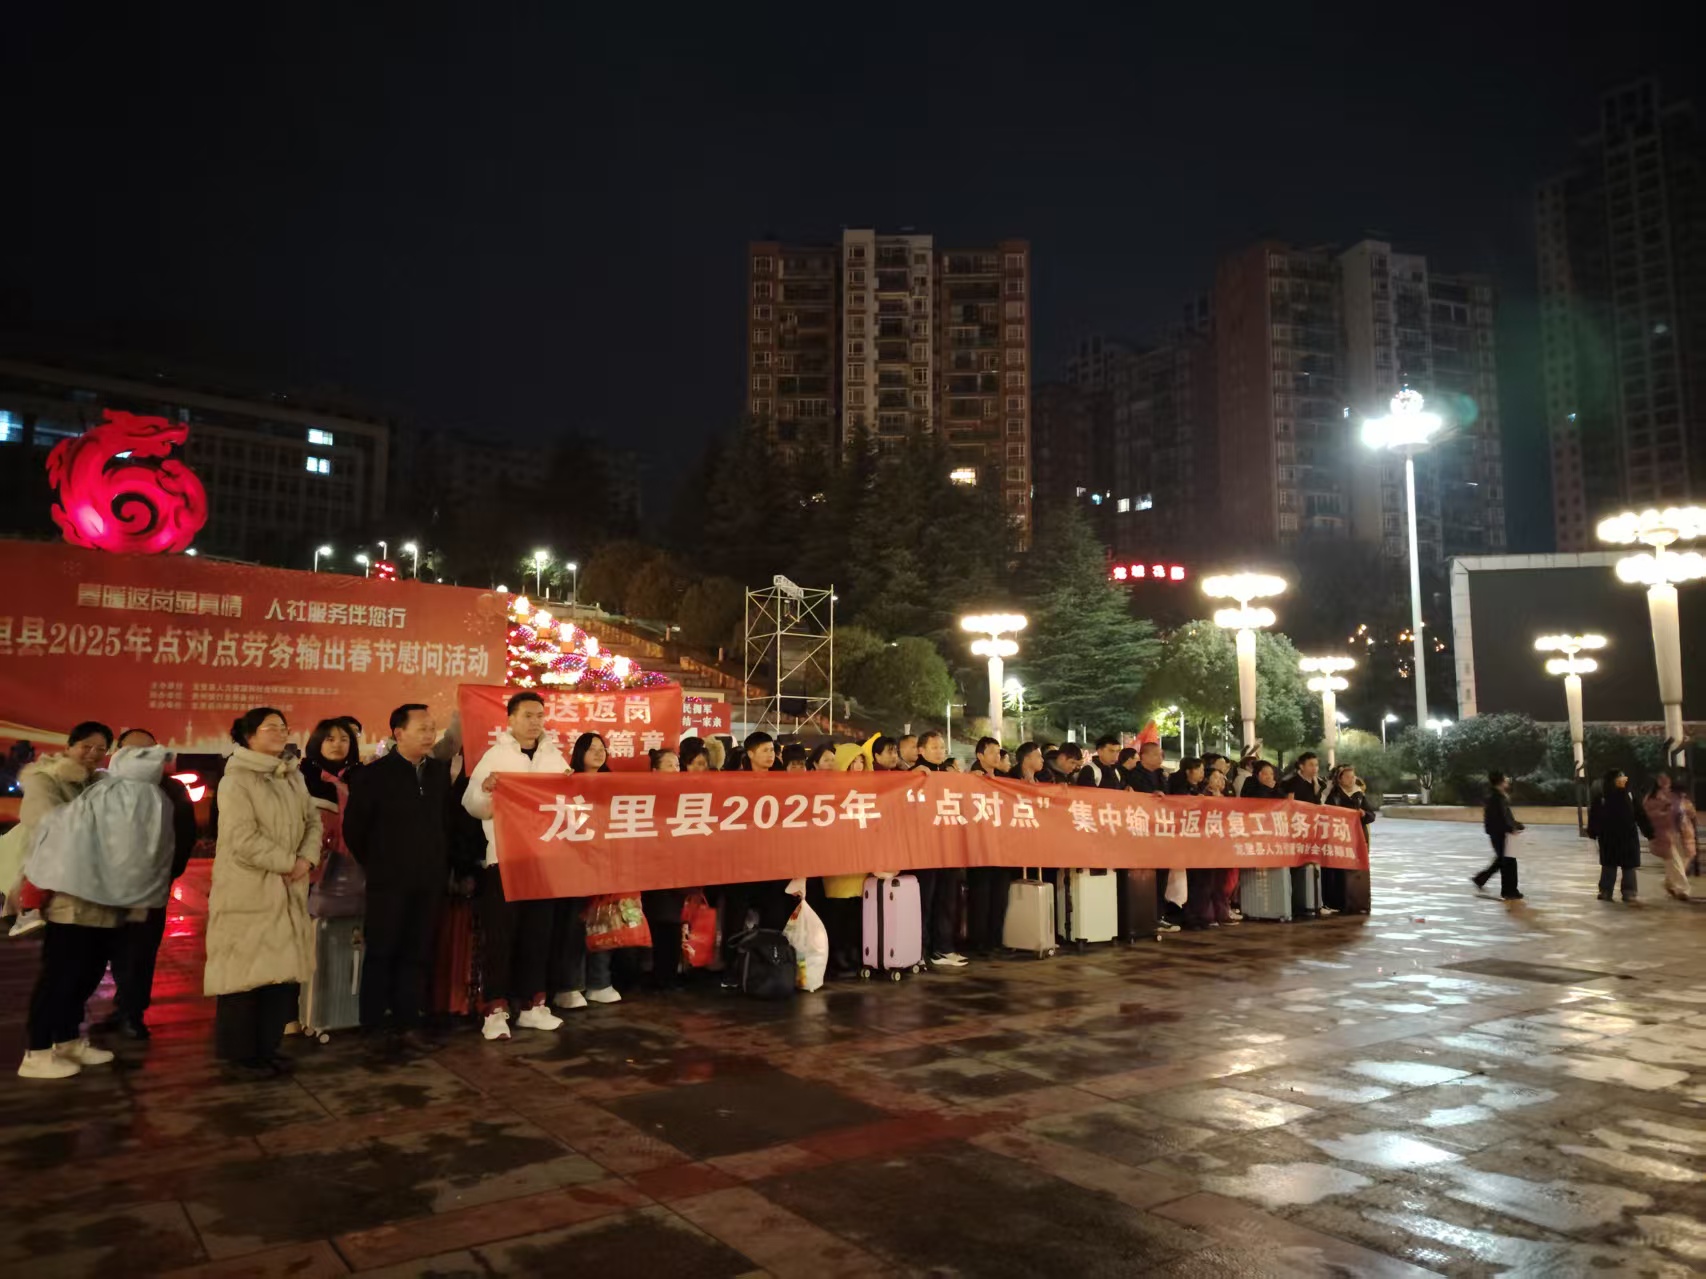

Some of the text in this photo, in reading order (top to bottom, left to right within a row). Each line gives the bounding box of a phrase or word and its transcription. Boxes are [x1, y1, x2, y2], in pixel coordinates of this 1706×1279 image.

[78, 583, 407, 629] 春暖返岗显真情 人社服务伴您行
[502, 693, 652, 724] 送返岗
